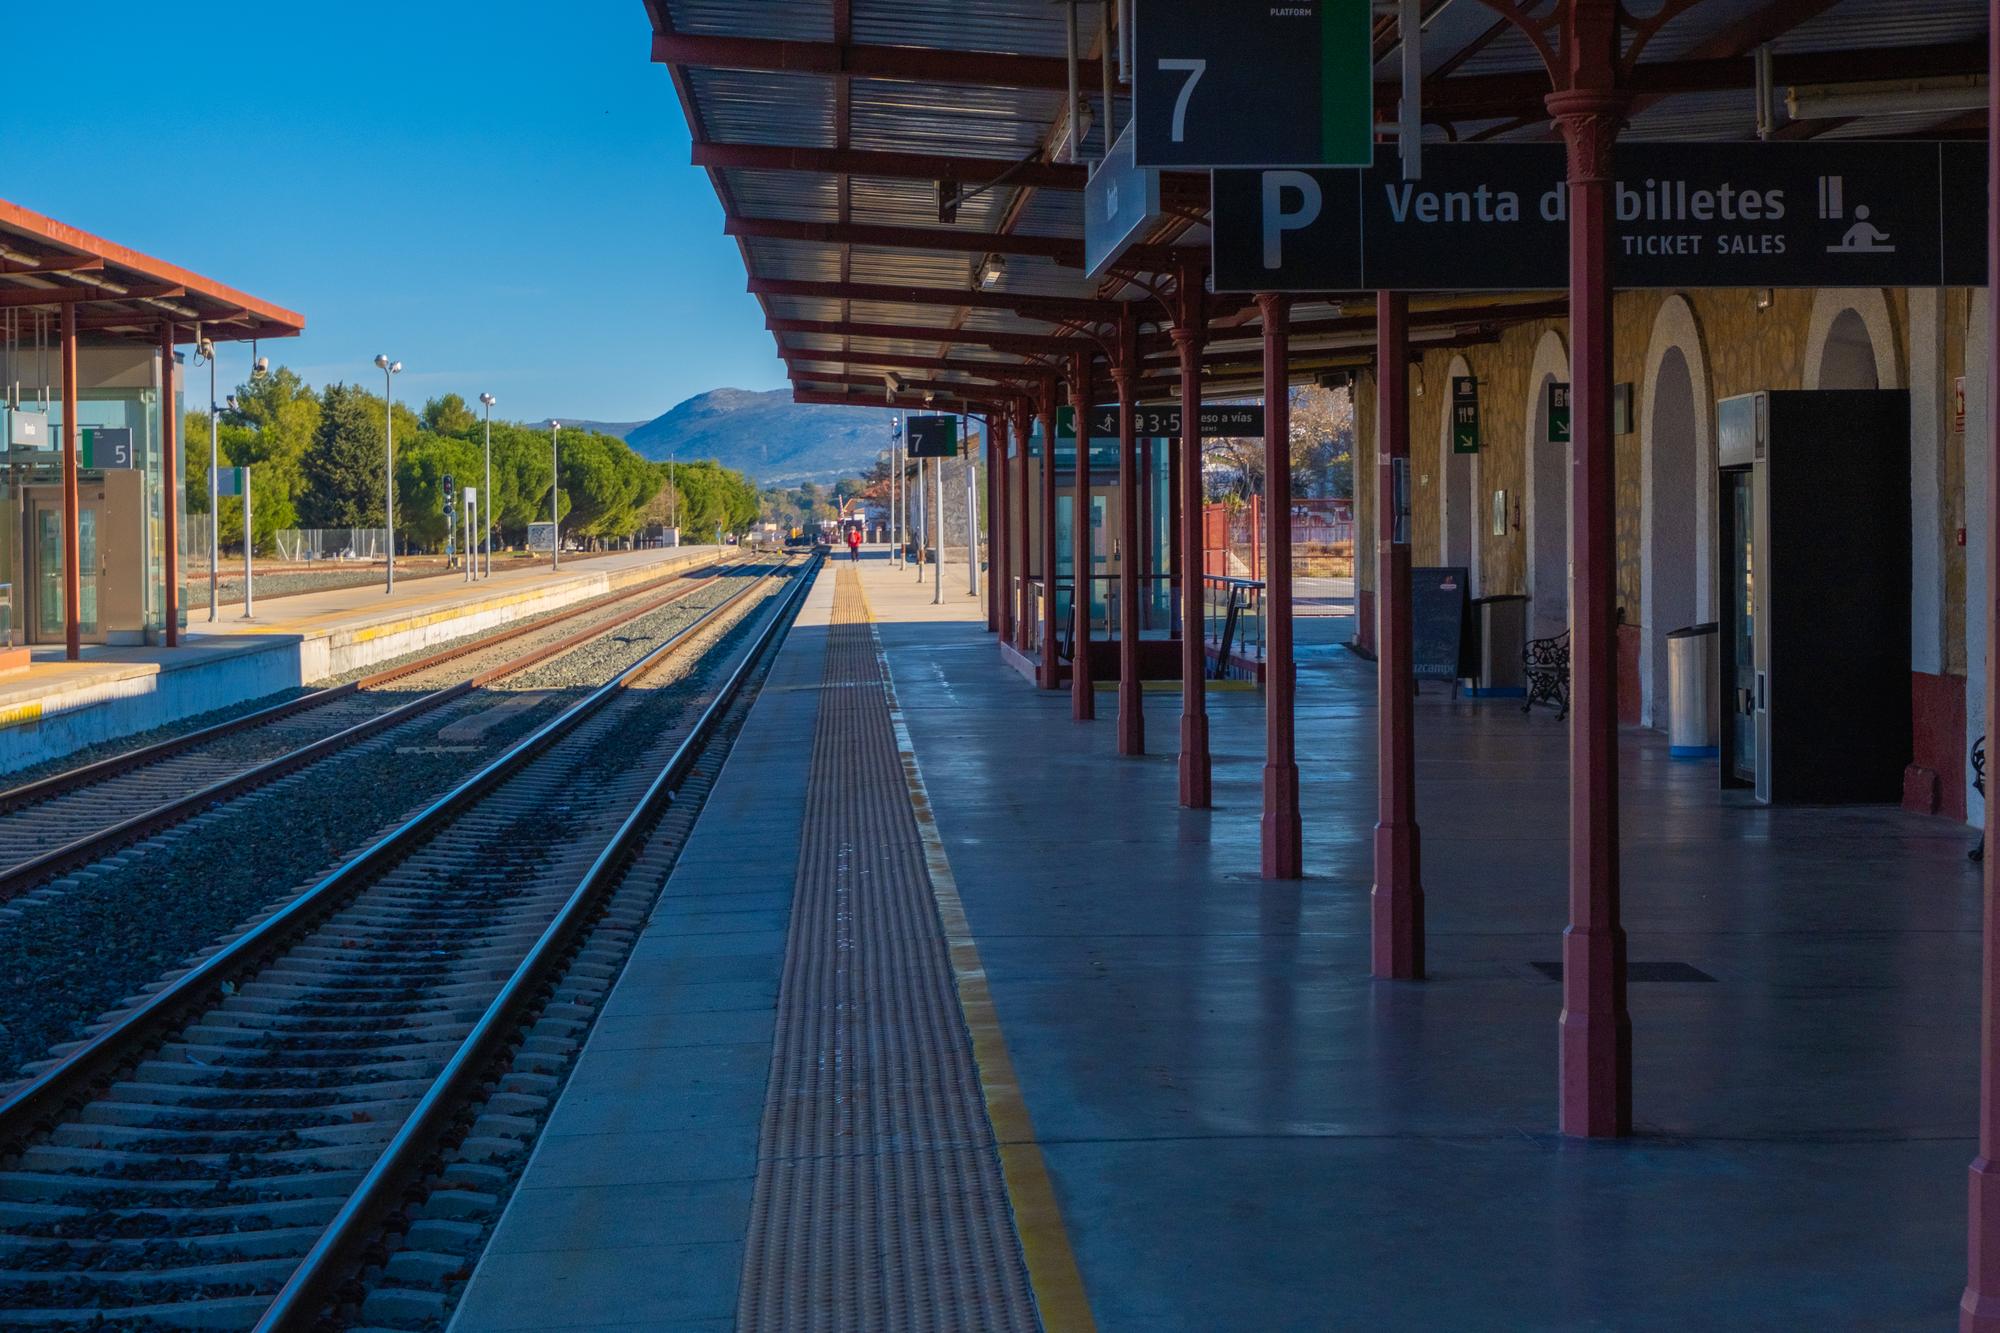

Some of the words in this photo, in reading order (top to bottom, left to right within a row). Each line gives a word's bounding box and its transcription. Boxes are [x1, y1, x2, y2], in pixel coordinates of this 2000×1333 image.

[1270, 8, 1312, 16] PLATFORM
[1158, 58, 1206, 142] 7
[1384, 183, 1520, 223] Venta
[1539, 181, 1567, 222] d
[1615, 178, 1785, 221] billetes
[1262, 170, 1322, 269] P
[1621, 235, 1702, 255] TICKET
[1717, 235, 1786, 255] SALES
[1200, 414, 1218, 423] eso
[1221, 414, 1228, 423] a
[912, 434, 923, 452] 7
[115, 445, 126, 463] 5
